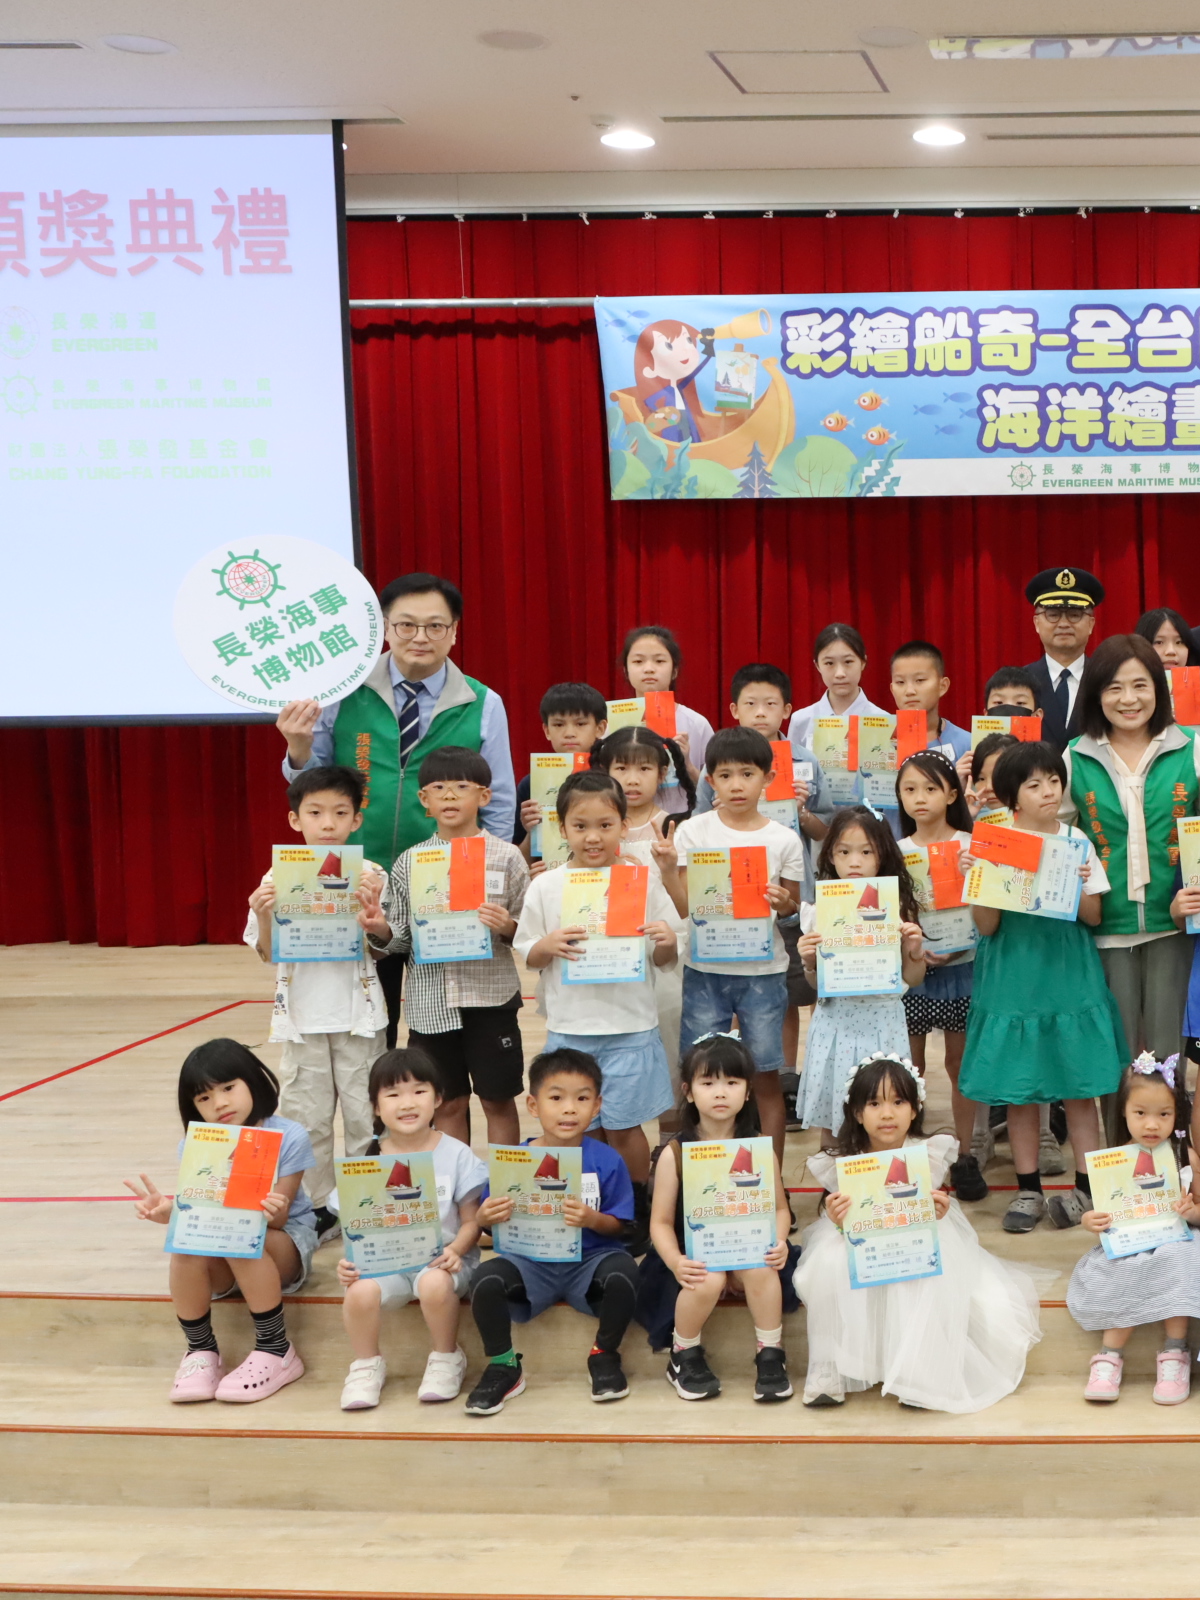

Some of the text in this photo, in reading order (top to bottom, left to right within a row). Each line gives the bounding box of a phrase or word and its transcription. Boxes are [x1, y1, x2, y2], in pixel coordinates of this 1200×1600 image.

[51, 338, 158, 352] EVERGREEN
[53, 398, 135, 409] EVERGREEN
[213, 397, 272, 408] MUSEUM
[9, 467, 68, 480] CHANG
[161, 465, 272, 479] FOUNDATION
[1042, 479, 1113, 488] EVERGREEN
[1117, 477, 1175, 487] MARITIME
[212, 583, 349, 667] 長榮海事
[365, 601, 377, 659] MUSEUM
[252, 623, 359, 691] 博物館
